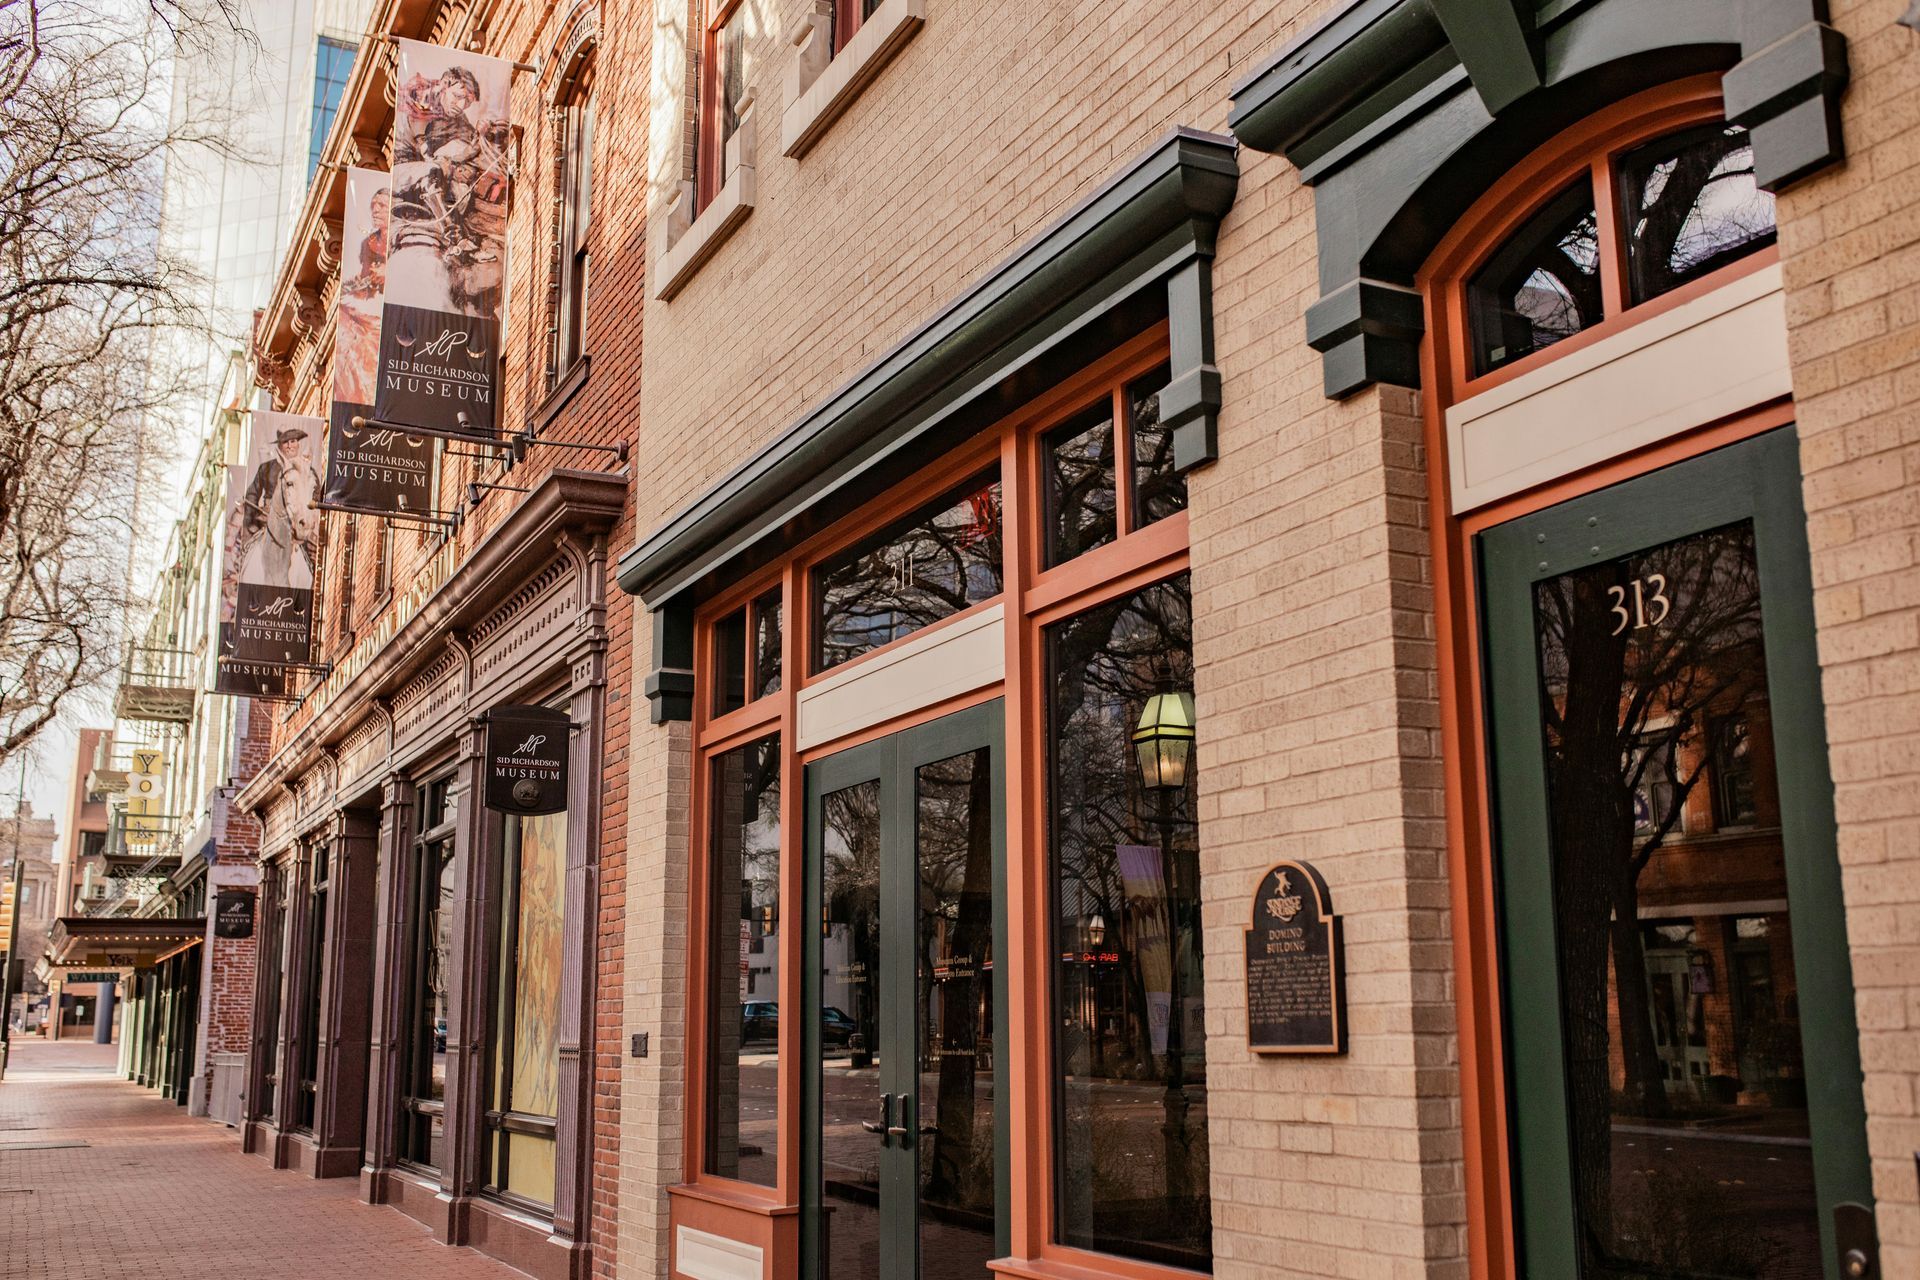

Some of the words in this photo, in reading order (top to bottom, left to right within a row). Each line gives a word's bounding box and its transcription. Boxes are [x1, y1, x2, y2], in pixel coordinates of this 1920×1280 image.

[388, 359, 409, 371] SID
[412, 362, 490, 383] RICHARDSON
[386, 375, 490, 404] MUSEUM
[336, 450, 355, 460] SID
[358, 452, 426, 469] RICHARDSON
[334, 464, 426, 487] MUSEUM
[891, 553, 914, 597] 311
[1607, 573, 1670, 637] 313
[256, 619, 307, 630] RICHARDSON
[240, 628, 306, 643] MUSEUM
[221, 663, 282, 677] MUSEUM
[496, 756, 511, 764] SID
[511, 757, 560, 767] RICHARDSON
[495, 767, 560, 780] MUSEUM
[1269, 927, 1303, 940] DOMINO
[1266, 941, 1305, 953] BUILDING
[71, 973, 118, 981] WATERS
